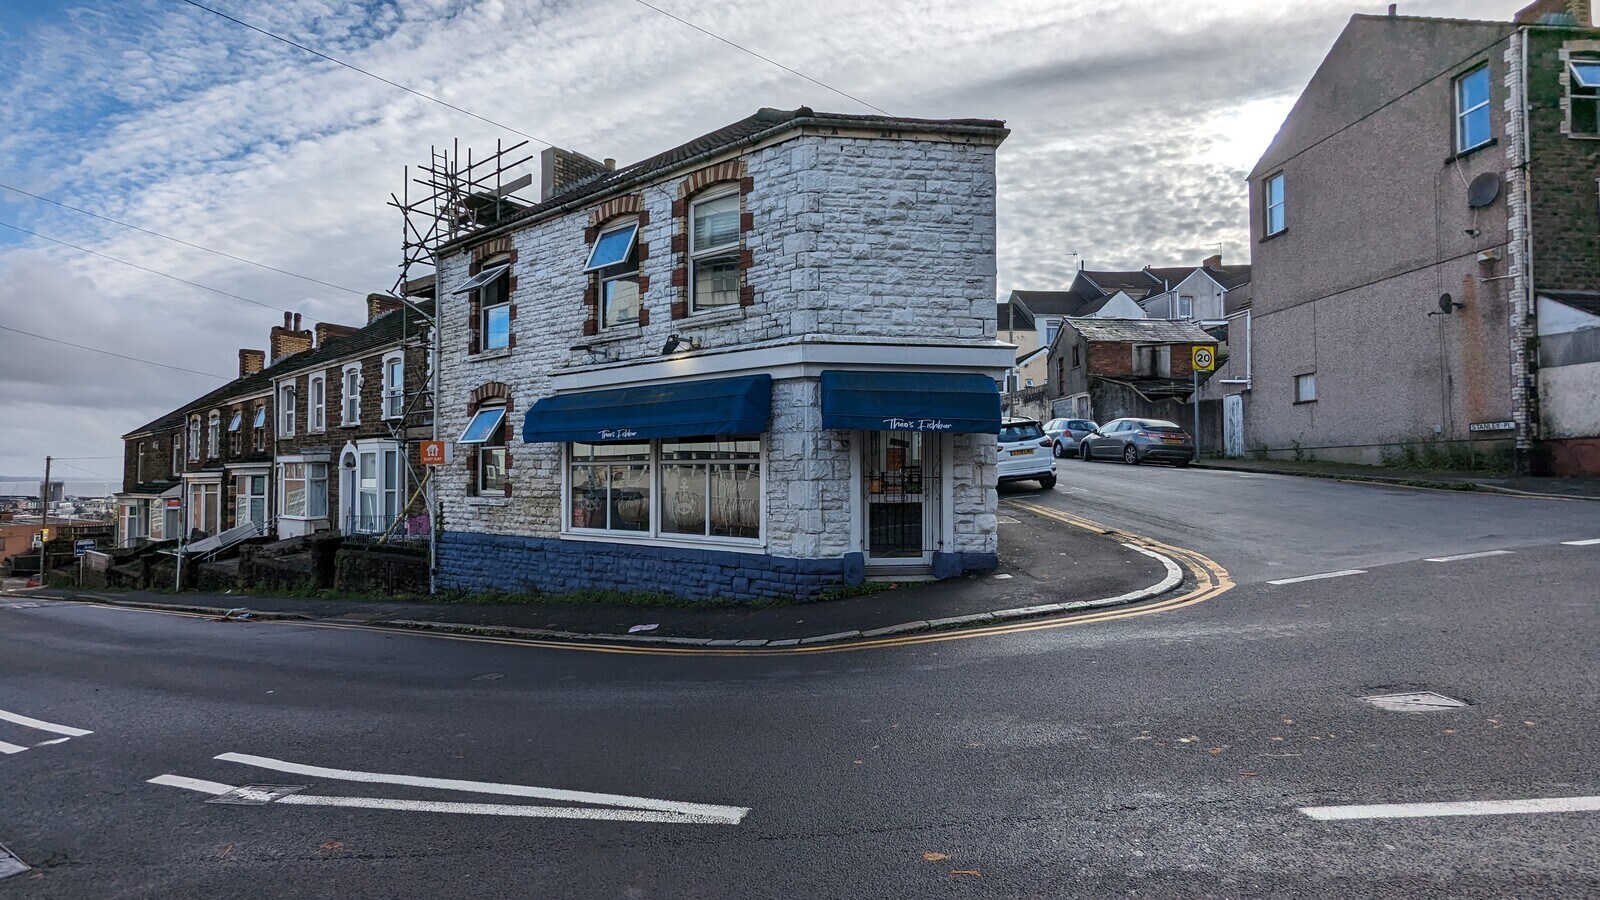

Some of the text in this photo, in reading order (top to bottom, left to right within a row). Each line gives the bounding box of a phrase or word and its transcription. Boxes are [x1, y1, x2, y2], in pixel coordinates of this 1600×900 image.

[1197, 354, 1210, 363] 20
[883, 418, 952, 431] Theo's Fishbar
